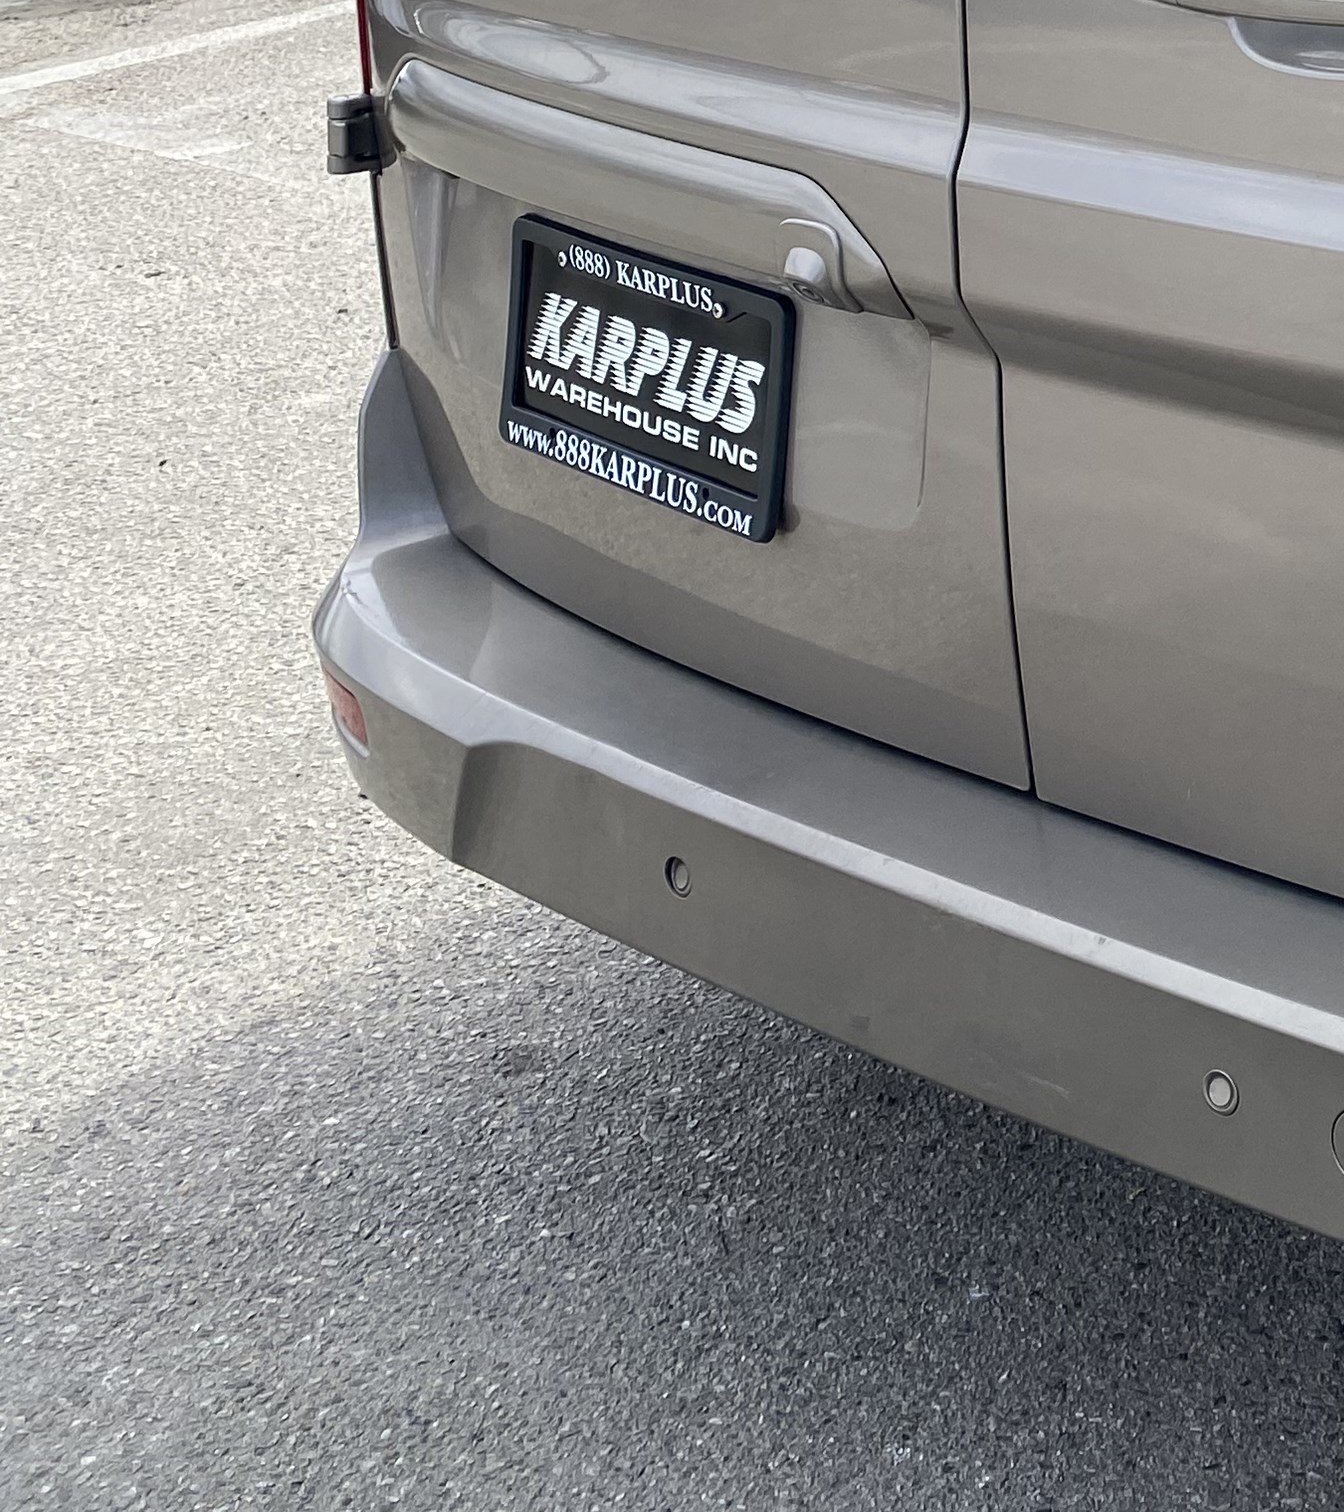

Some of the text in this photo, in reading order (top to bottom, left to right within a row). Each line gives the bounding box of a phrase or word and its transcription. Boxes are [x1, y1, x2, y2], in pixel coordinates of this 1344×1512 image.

[568, 243, 714, 313] (888) KARPLUS
[526, 292, 766, 434] KARPLUS
[525, 366, 758, 473] WAREHOUSE INC
